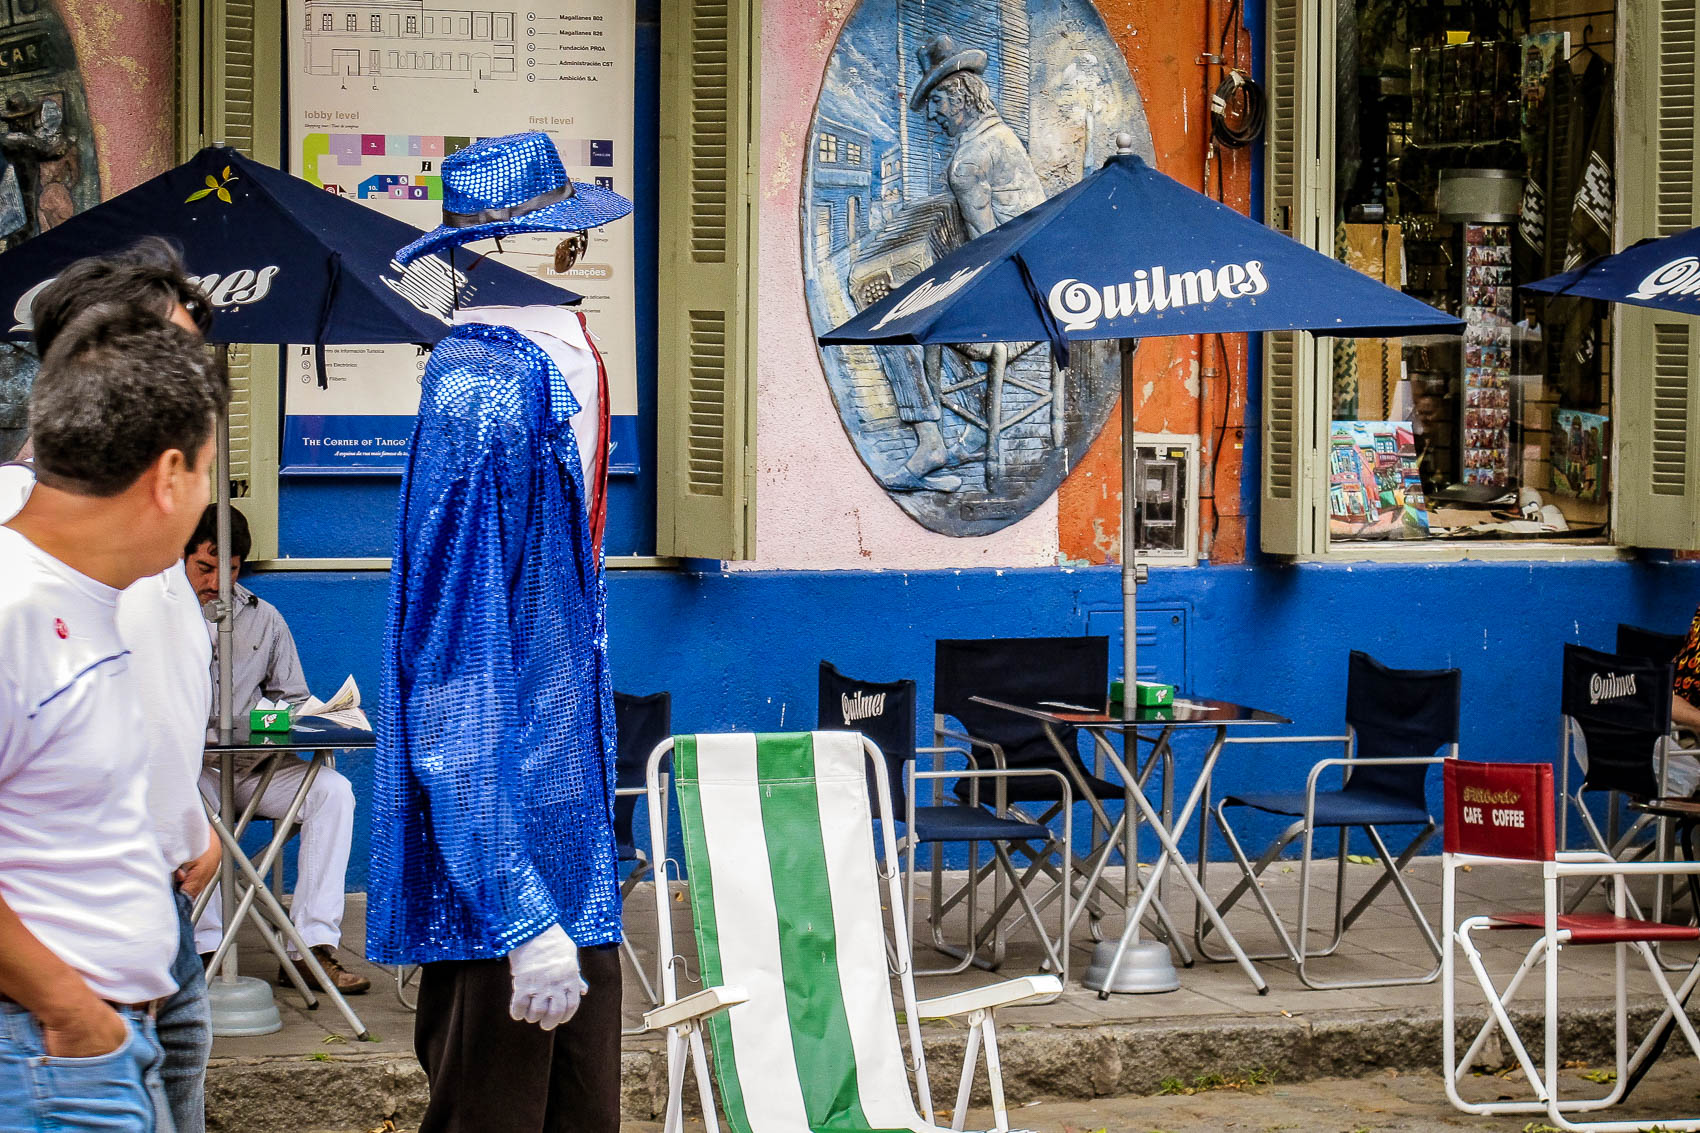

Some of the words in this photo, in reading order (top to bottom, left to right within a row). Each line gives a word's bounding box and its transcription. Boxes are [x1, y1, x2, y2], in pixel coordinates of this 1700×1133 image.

[304, 111, 332, 120] lobby
[529, 116, 549, 124] first
[551, 117, 574, 125] level
[546, 267, 607, 278] Inrmações
[1049, 260, 1269, 332] Quilmes
[1590, 672, 1636, 705] Quilmes
[841, 691, 886, 725] Quilmes
[1463, 806, 1484, 825] CAFE
[1492, 809, 1525, 828] COFFEE
